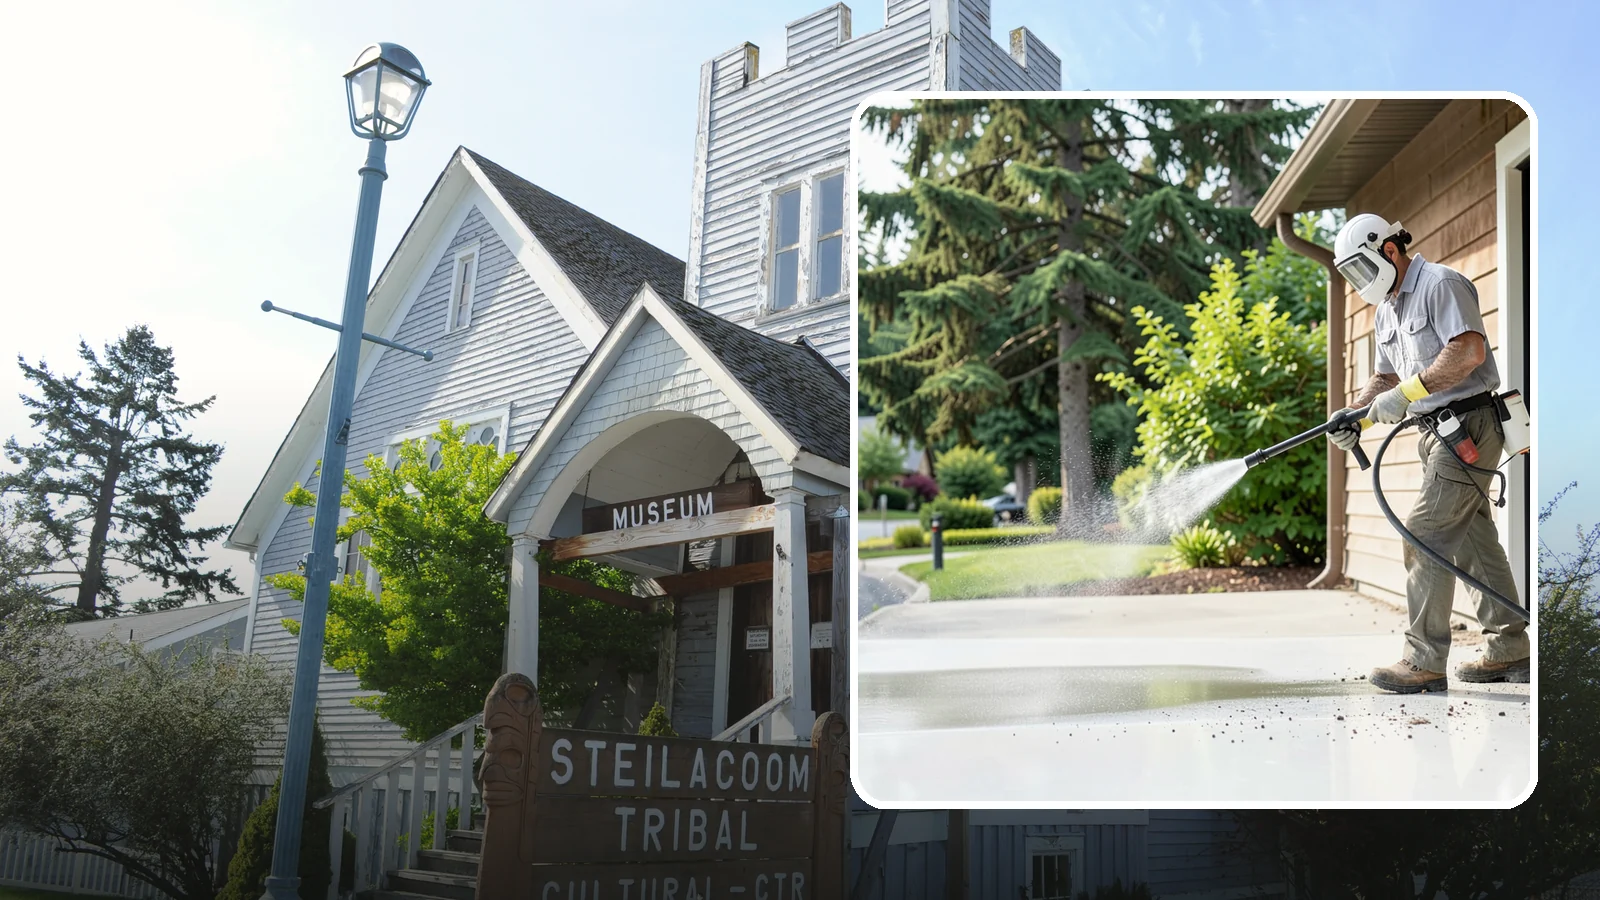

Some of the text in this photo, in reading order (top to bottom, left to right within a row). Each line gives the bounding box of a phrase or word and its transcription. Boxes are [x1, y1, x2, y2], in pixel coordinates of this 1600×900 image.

[612, 491, 714, 531] MUSEUM
[550, 738, 810, 793] STEILACOOM
[614, 806, 758, 852] TRIBAL
